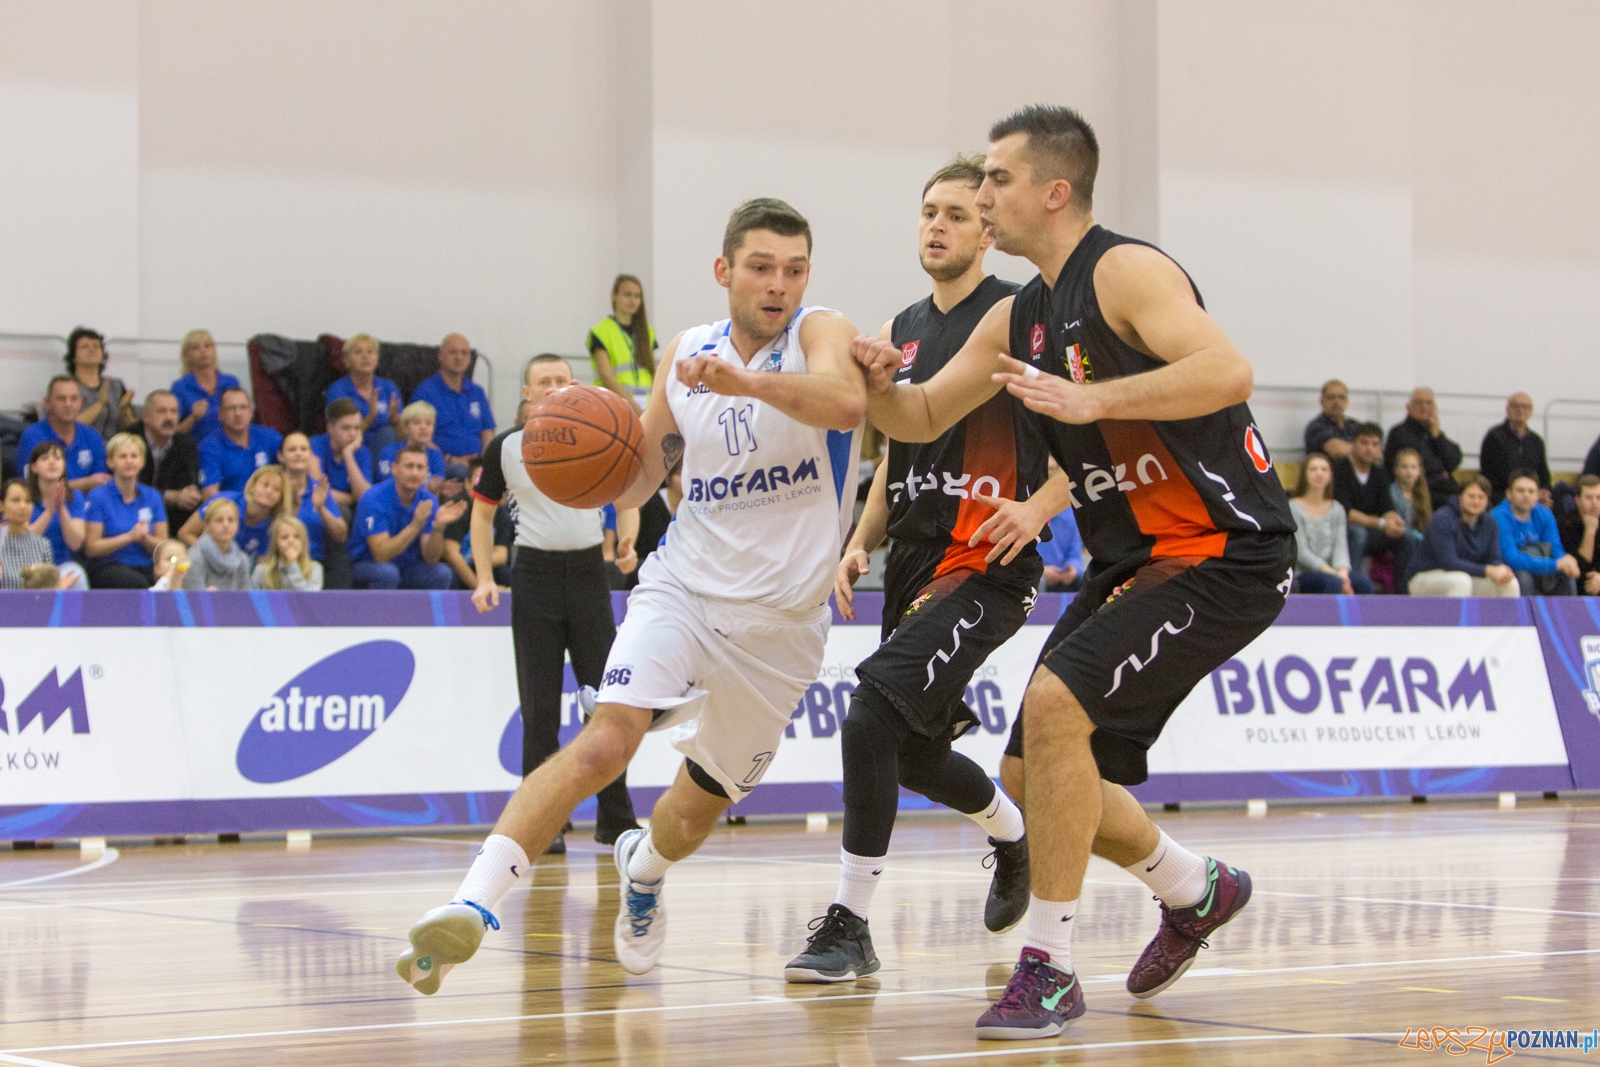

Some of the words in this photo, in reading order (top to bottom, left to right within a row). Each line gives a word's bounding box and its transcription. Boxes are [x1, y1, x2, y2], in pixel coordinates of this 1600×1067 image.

[718, 403, 758, 456] 11
[688, 456, 819, 503] BIOFARM
[688, 505, 716, 515] OLSKI
[718, 494, 781, 513] PRODUCENT
[785, 484, 822, 501] LEKÓW
[1210, 654, 1497, 715] BIOFARM
[259, 685, 386, 731] atrem
[1246, 727, 1307, 743] POLSKI
[1317, 726, 1416, 742] PRODUCENT
[1427, 721, 1482, 741] LEKÓW
[0, 747, 60, 770] KÓW
